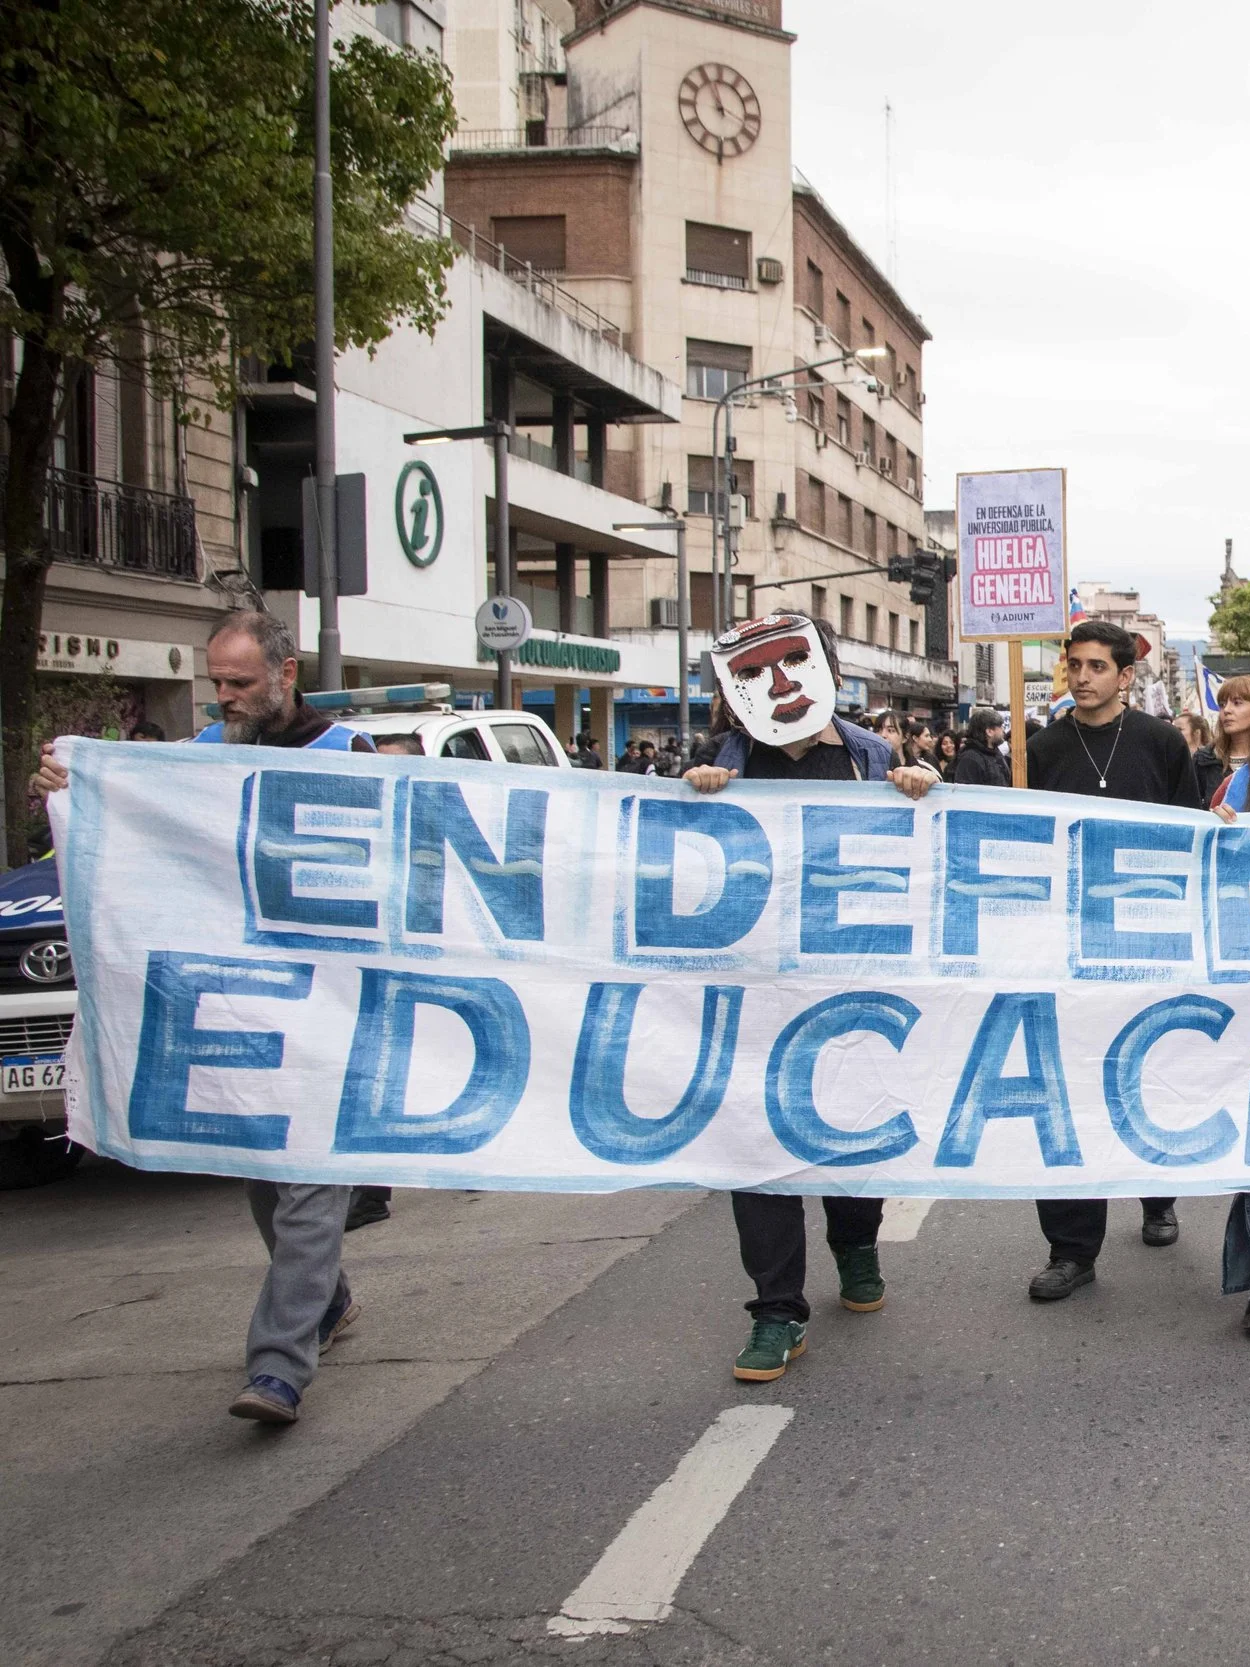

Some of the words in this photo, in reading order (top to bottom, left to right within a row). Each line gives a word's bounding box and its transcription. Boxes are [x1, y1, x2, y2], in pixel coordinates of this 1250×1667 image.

[976, 507, 986, 520] EN
[988, 505, 1022, 520] DEFENSA
[1024, 504, 1034, 518] DE
[1036, 504, 1045, 517] LA
[968, 520, 1019, 535] UNIVERSIDAD
[976, 536, 1048, 571] HUELGA
[972, 571, 1054, 606] GENERAL
[1002, 612, 1035, 622] ADIUNT
[239, 769, 548, 957] EN
[8, 1067, 34, 1088] AG
